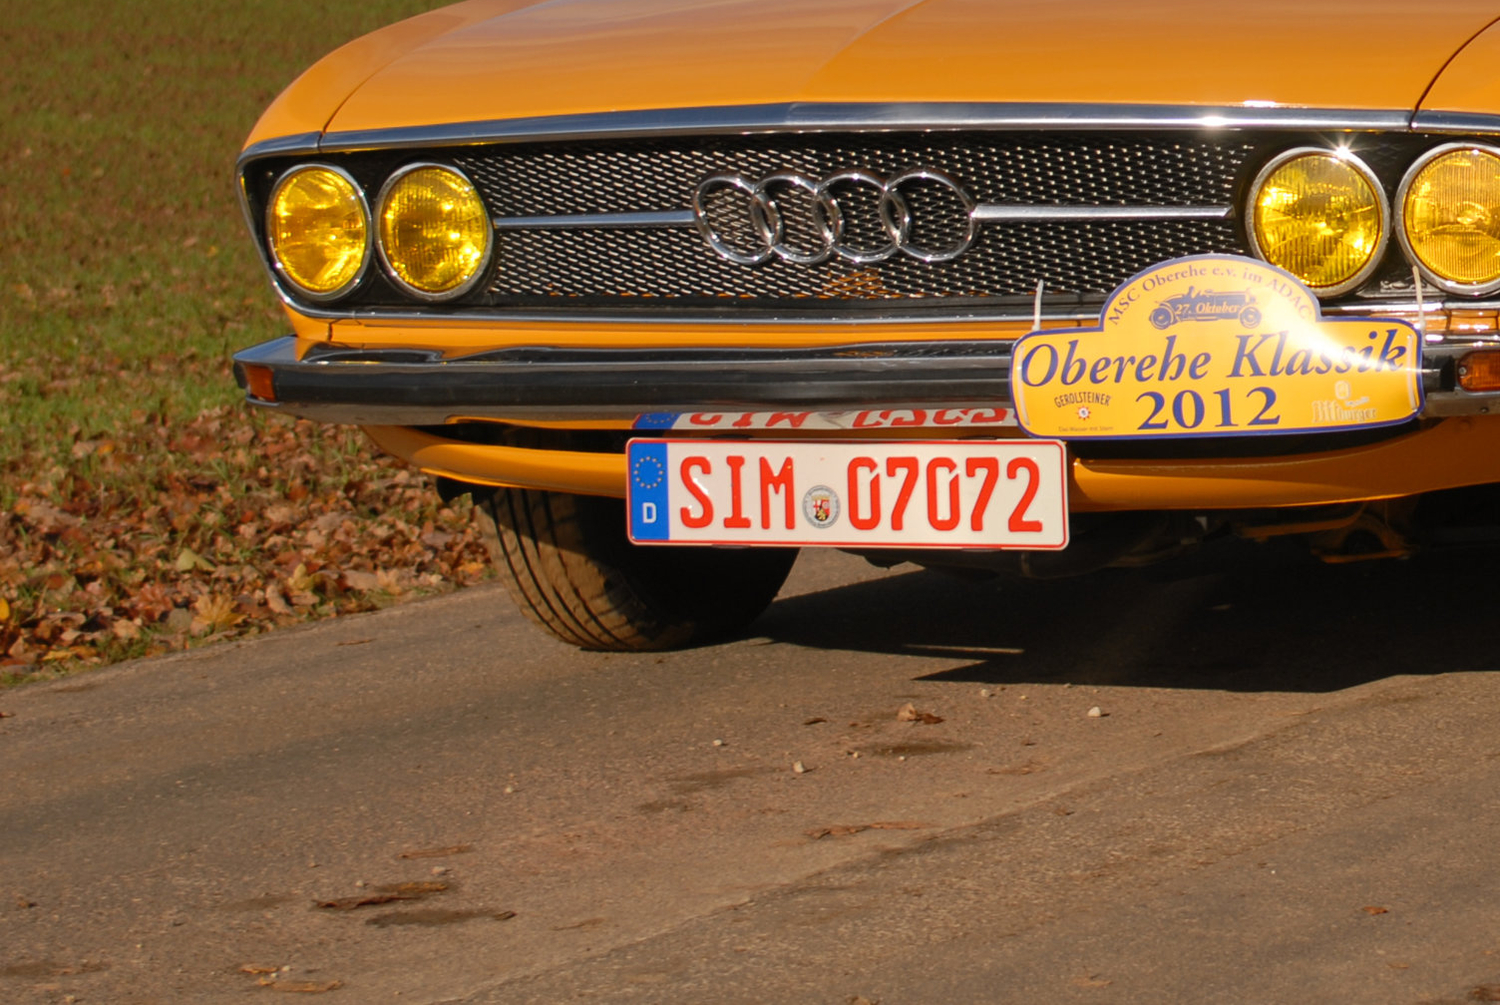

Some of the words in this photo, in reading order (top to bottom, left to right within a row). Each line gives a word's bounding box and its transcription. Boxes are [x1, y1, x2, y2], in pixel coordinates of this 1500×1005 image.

[1108, 288, 1141, 325] MSC
[1142, 264, 1208, 292] Oberehe
[1243, 267, 1263, 283] im
[1265, 278, 1313, 320] ADAC
[1174, 303, 1192, 315] 27.
[1196, 301, 1240, 315] Oktober
[1021, 334, 1211, 387] Oberehe
[1226, 329, 1407, 378] Klassik
[1054, 391, 1111, 408] GEROLSTEINER
[1135, 386, 1281, 430] 2012
[642, 502, 657, 523] D
[680, 455, 796, 529] SIM
[847, 456, 1044, 532] 07072
